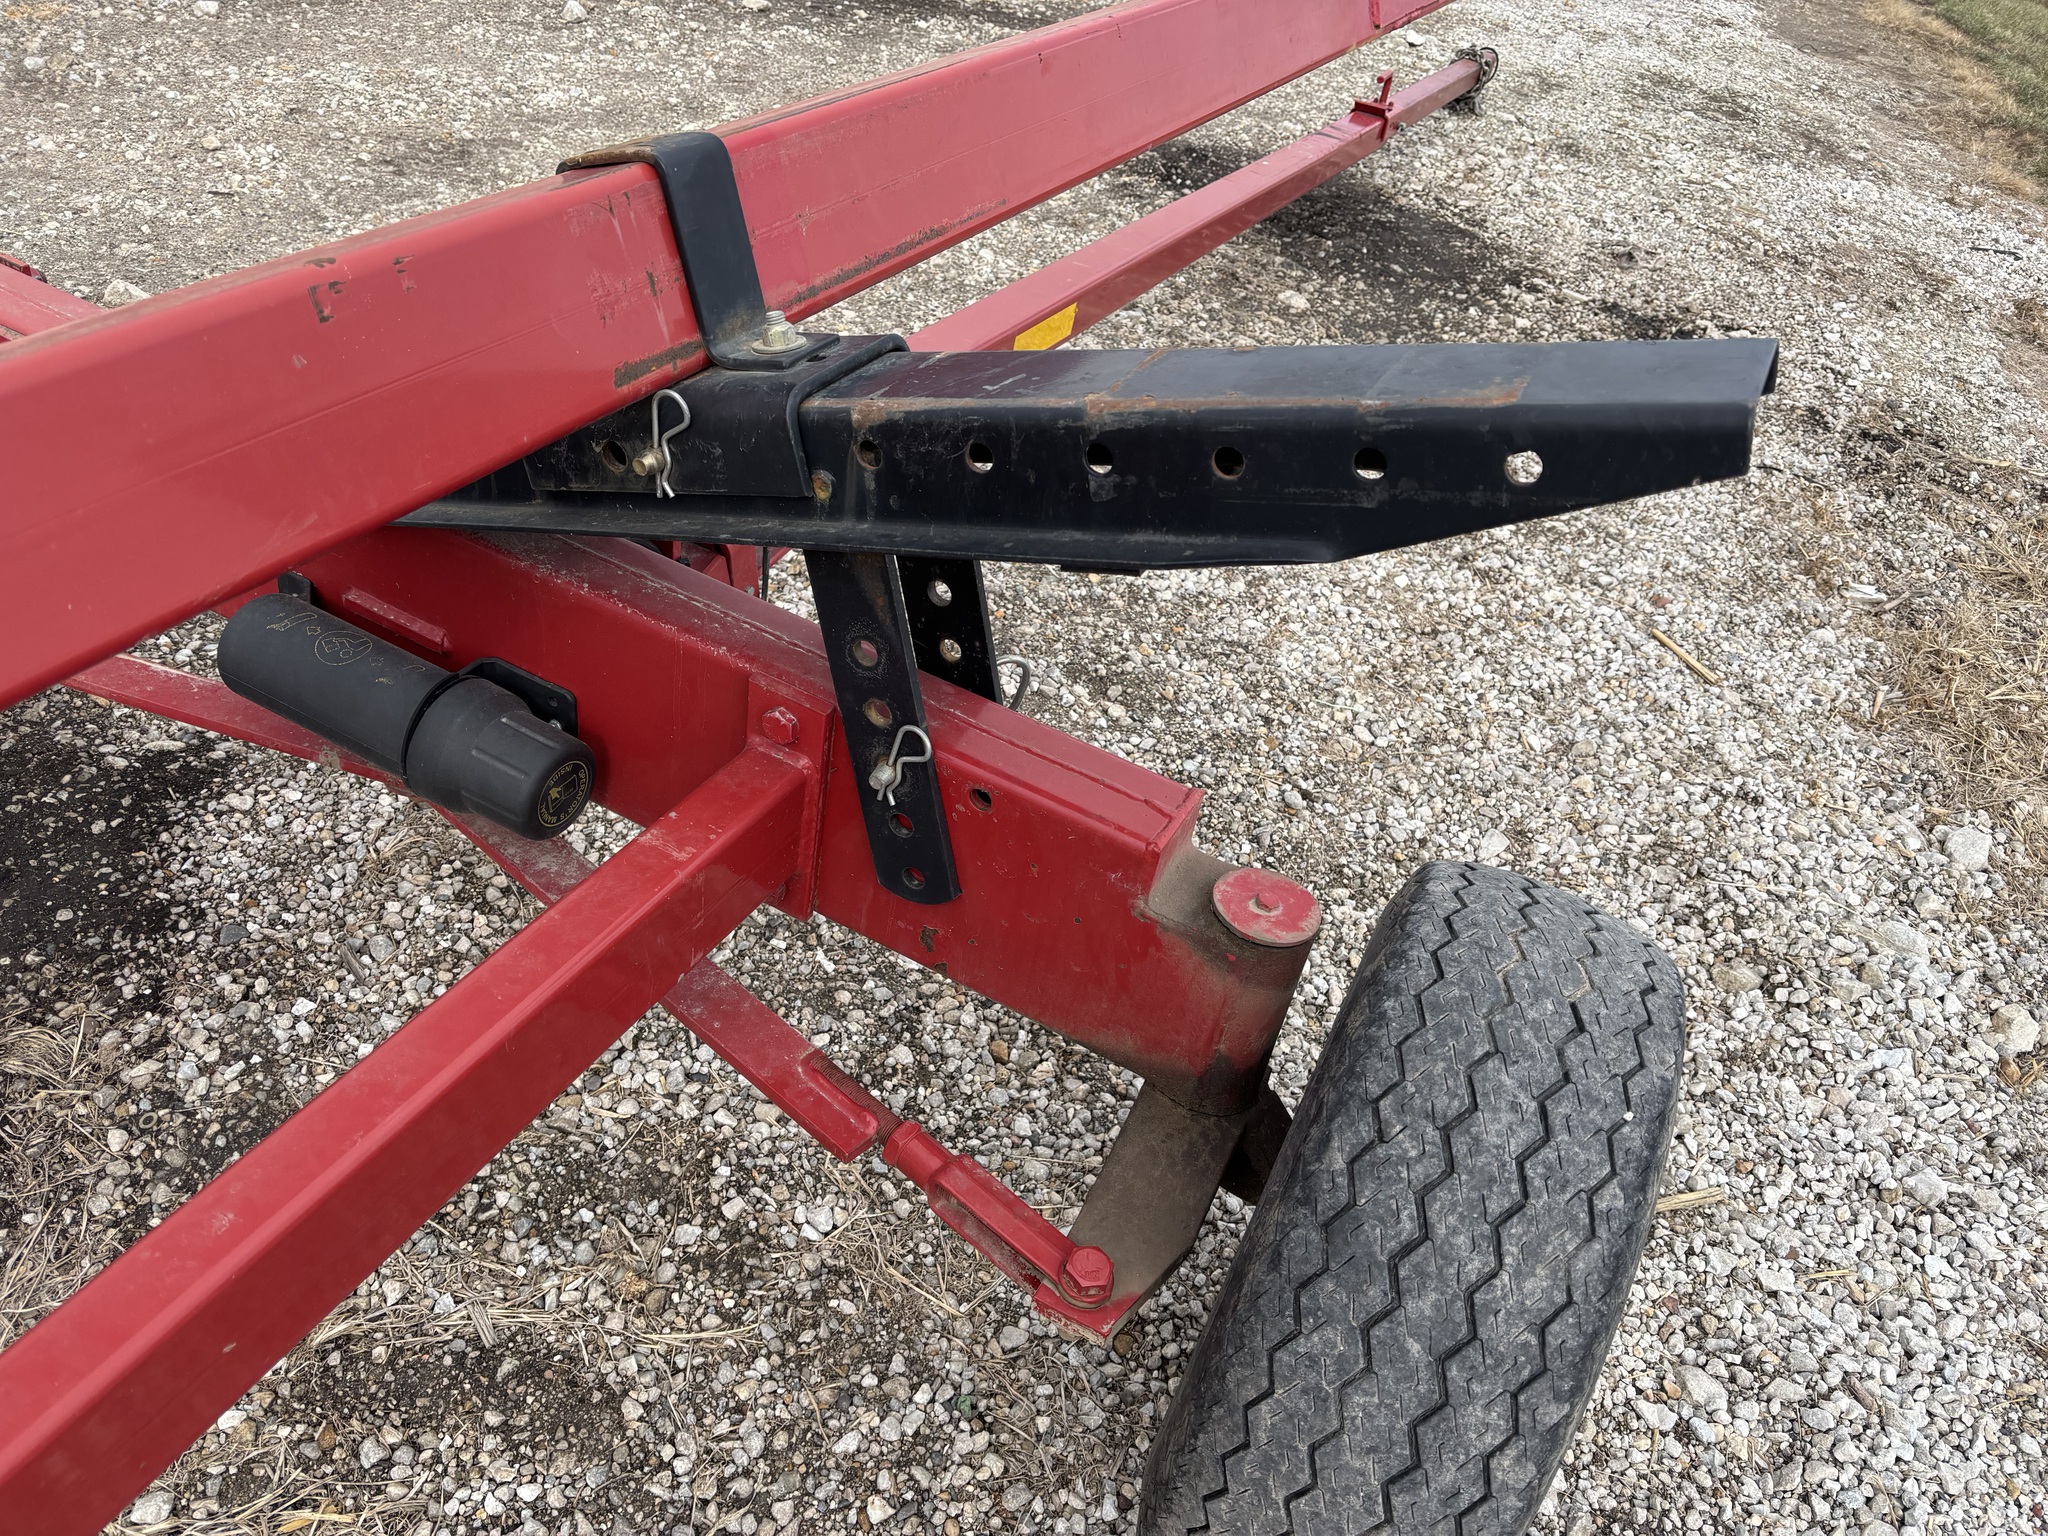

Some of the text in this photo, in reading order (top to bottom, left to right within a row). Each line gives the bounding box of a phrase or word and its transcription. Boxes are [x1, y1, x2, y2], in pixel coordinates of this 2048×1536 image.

[549, 764, 573, 786] INSIDE
[540, 769, 586, 824] OPERATOR'S MANUAL
